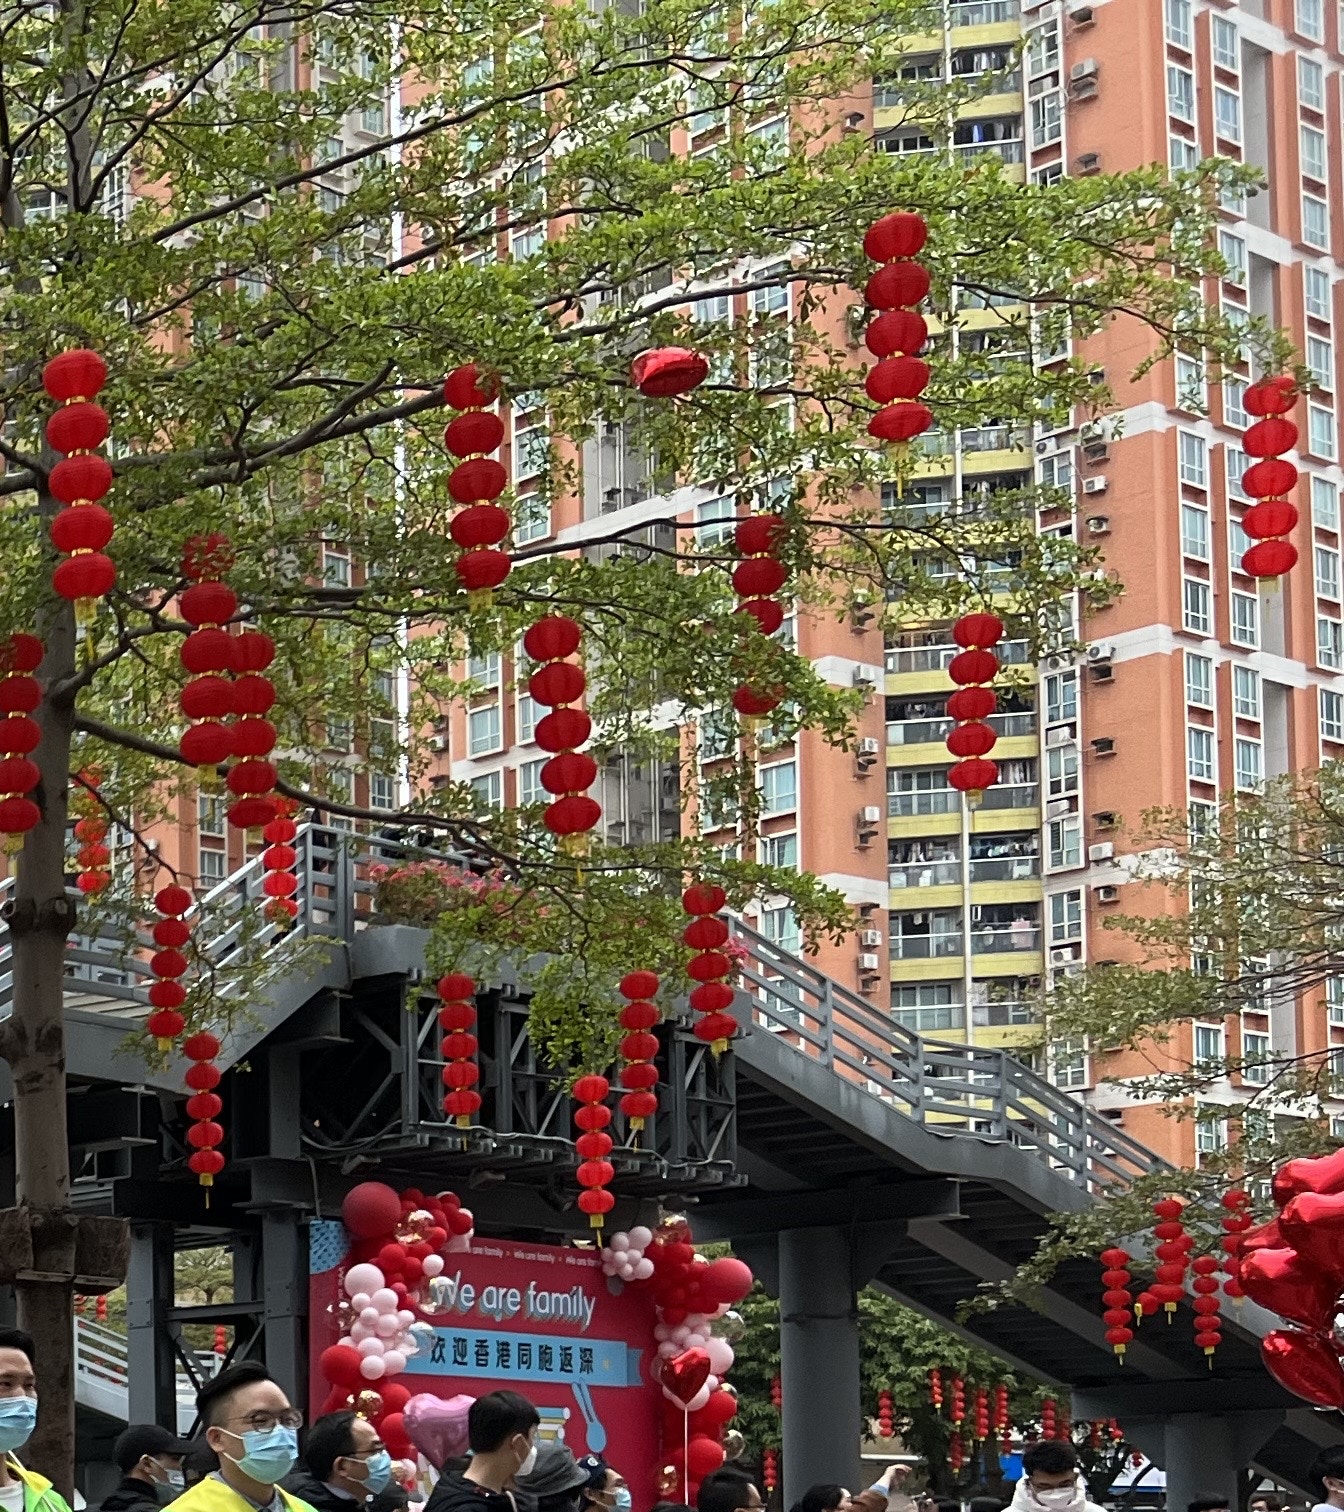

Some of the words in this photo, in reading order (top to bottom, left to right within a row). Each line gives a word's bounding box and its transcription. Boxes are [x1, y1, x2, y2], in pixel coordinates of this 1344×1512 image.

[434, 1270, 475, 1308] We
[482, 1285, 521, 1314] are
[527, 1280, 596, 1328] family
[429, 1335, 595, 1376] 欢迎香港同胞返深
